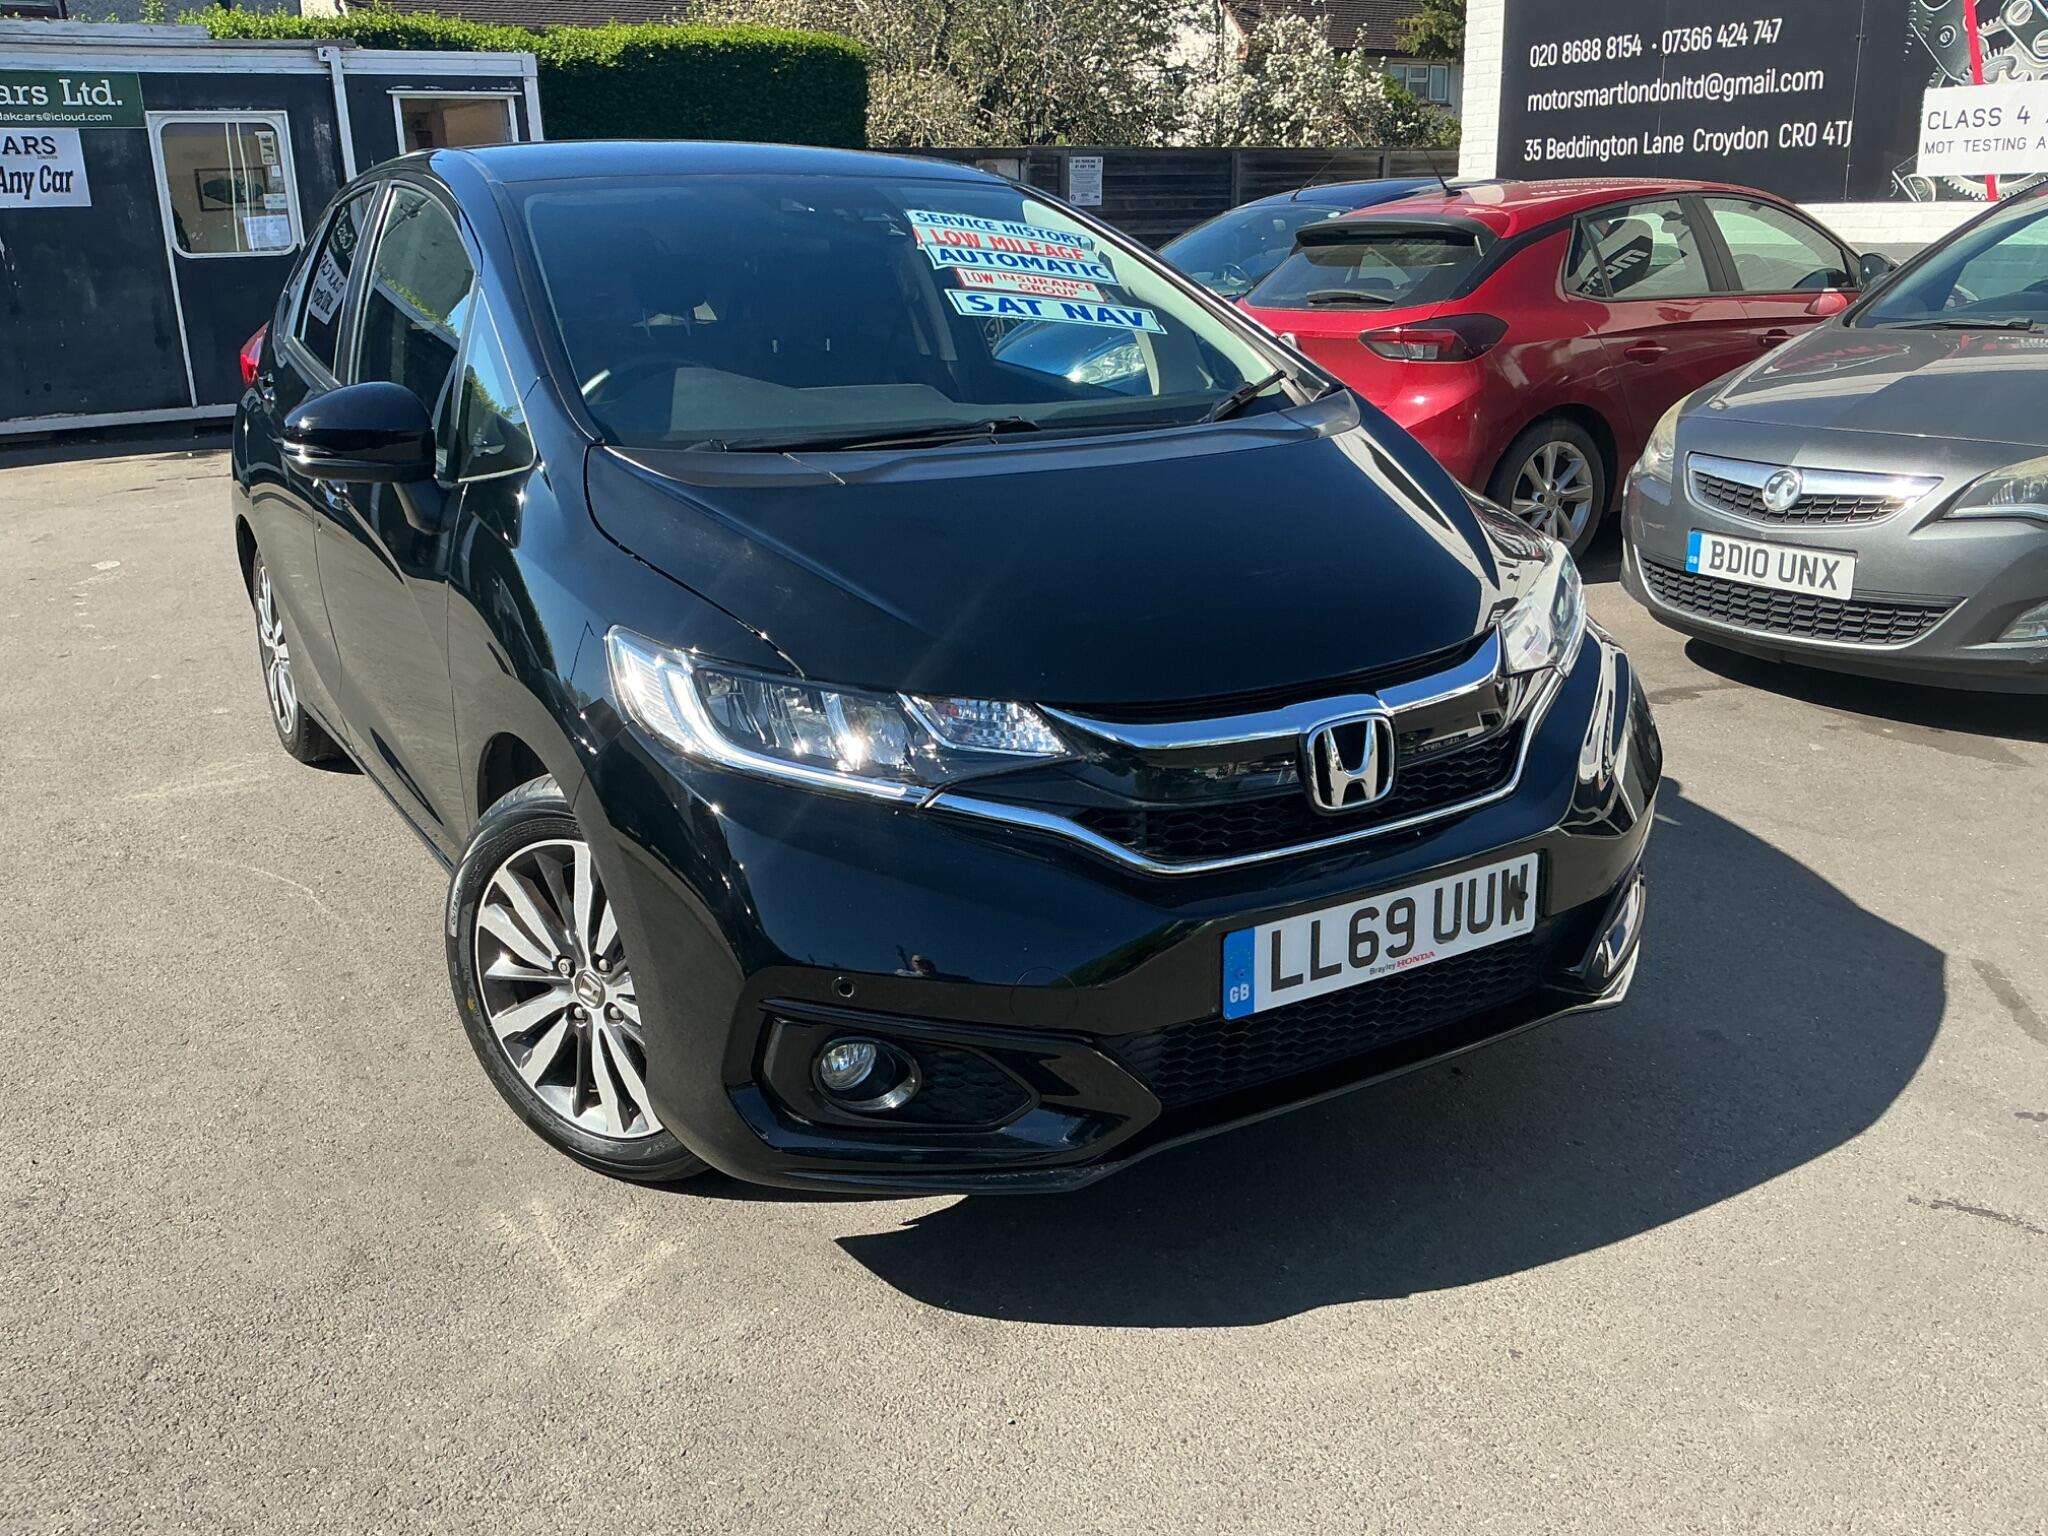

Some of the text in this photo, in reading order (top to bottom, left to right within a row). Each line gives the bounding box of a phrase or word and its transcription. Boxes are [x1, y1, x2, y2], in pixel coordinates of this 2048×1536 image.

[1529, 17, 1783, 68] 020 8688 8154 07366 424 747
[58, 78, 123, 106] Ltd.
[1527, 67, 1824, 112] motorsmartlondonltd@gmail.com
[1927, 105, 2031, 130] CLASS 4
[2, 135, 57, 155] ARS
[1523, 138, 1542, 162] 35
[1546, 134, 1638, 162] Beddington
[1643, 131, 1684, 154] Lane
[1692, 125, 1769, 156] Croydon
[1822, 120, 1853, 148] 4TJ
[1924, 140, 1954, 154] MOT
[1963, 137, 2028, 153] TESTING
[0, 164, 74, 200] Any Car
[915, 211, 1084, 247] SERVICE HISTORY
[930, 229, 1085, 261] LOW MILEAGE
[939, 248, 1109, 279] AUTOMATIC
[963, 271, 1095, 292] LOW INSURANCE
[1018, 284, 1079, 297] GROUP
[965, 294, 1143, 327] SAT NAV
[1708, 540, 1841, 591] BD10 UNX
[1270, 863, 1529, 993] LL69 UUW
[1396, 950, 1436, 968] HONDA
[1229, 983, 1250, 1004] GB
